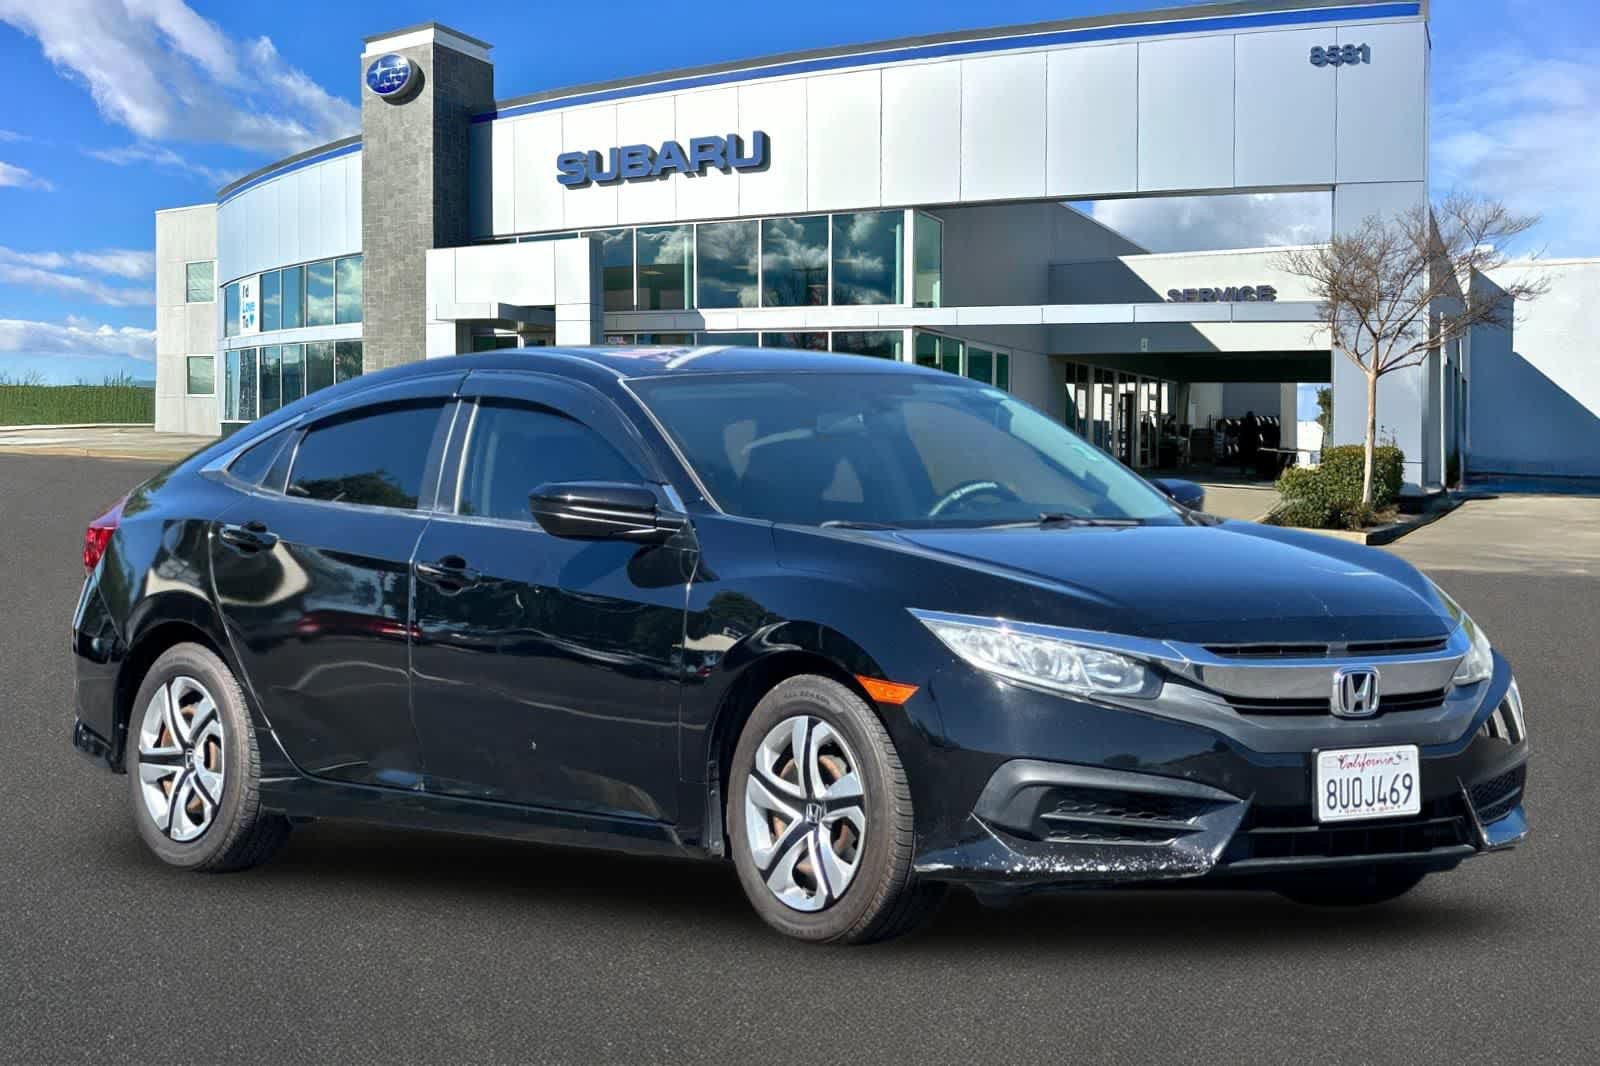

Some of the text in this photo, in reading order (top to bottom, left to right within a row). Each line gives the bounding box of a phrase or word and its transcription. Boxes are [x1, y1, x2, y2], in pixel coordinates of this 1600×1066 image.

[556, 129, 769, 188] SUBARU
[1166, 284, 1278, 303] SERVICE
[1337, 753, 1395, 773] California
